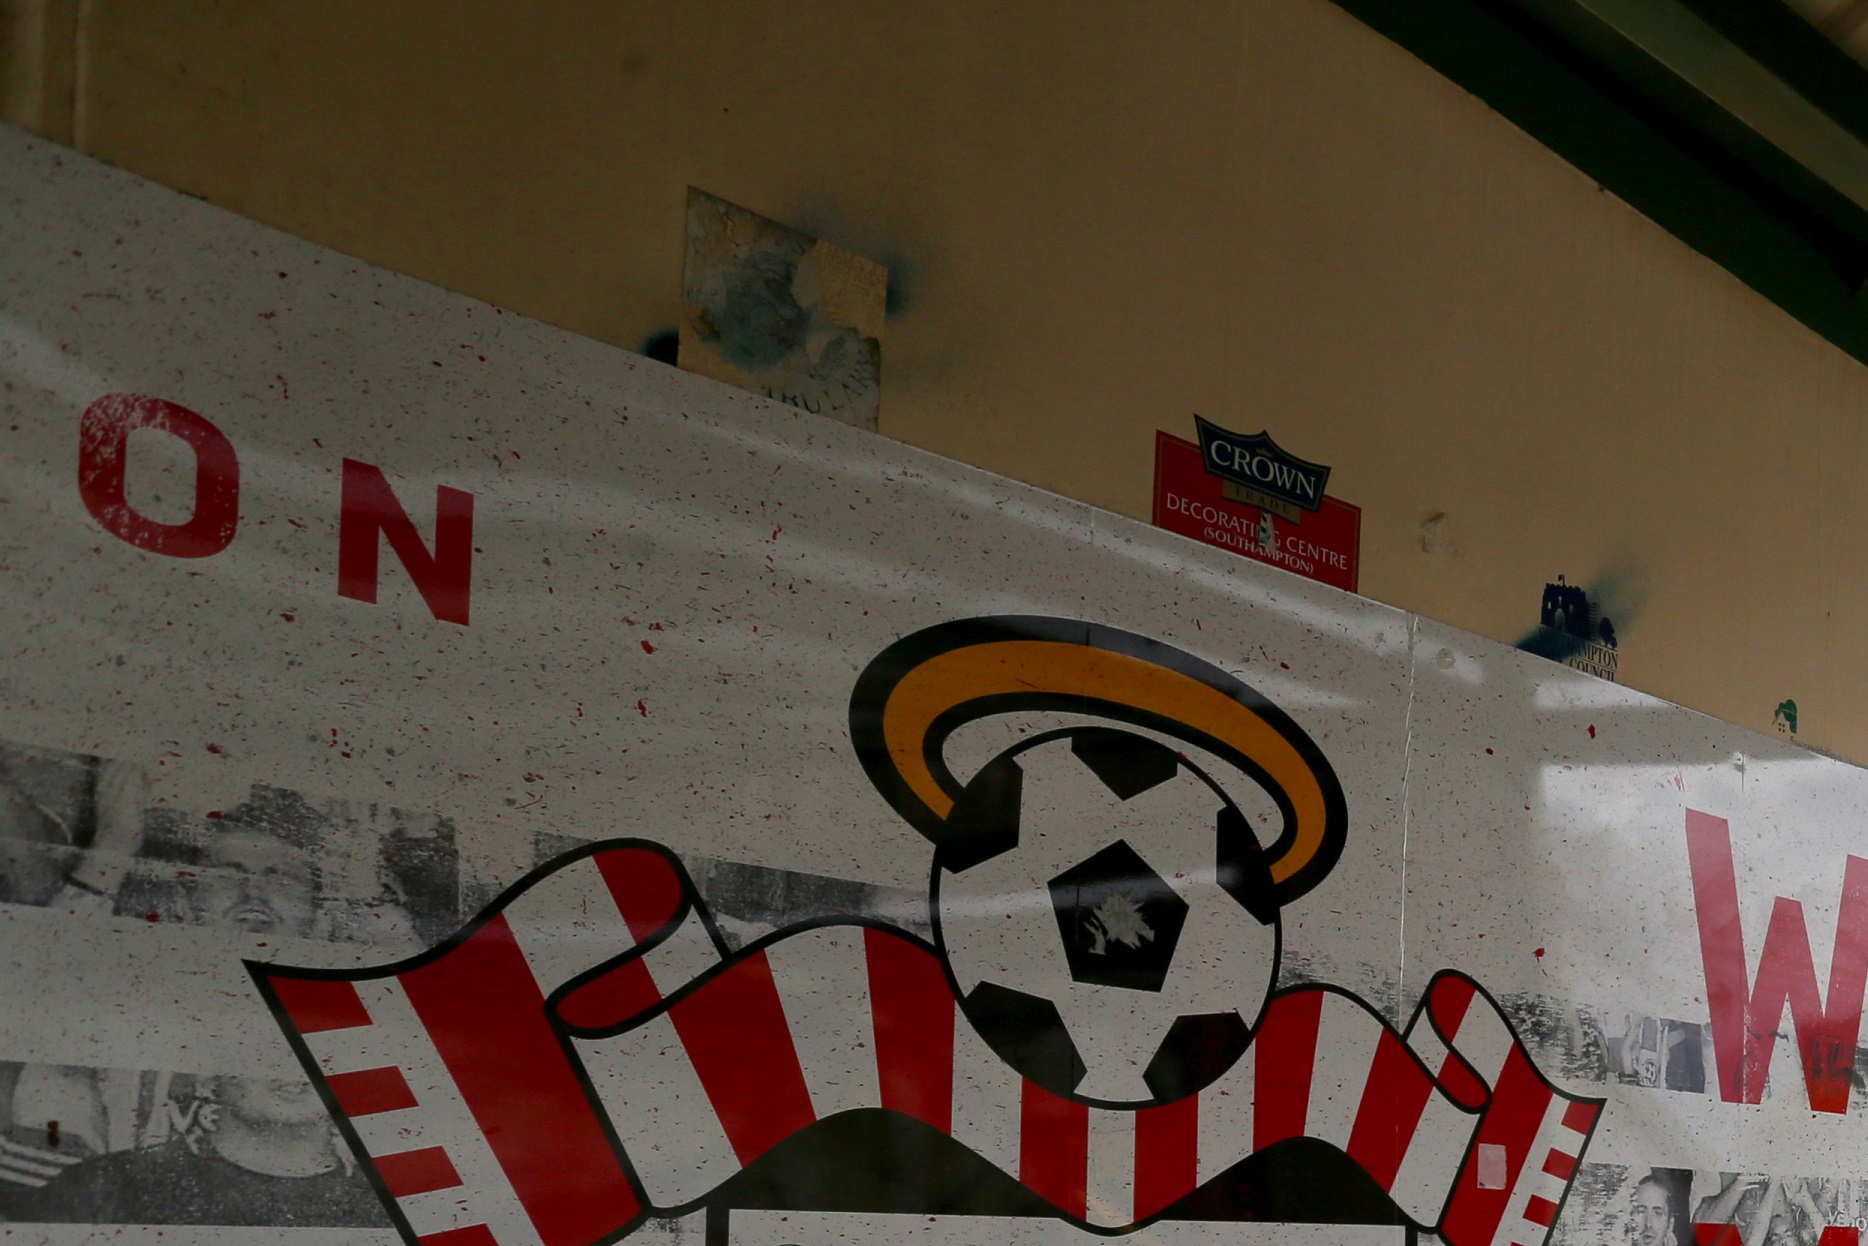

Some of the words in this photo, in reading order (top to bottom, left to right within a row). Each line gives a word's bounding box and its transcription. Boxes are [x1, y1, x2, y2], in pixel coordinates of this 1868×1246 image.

[1210, 440, 1316, 500] CROWN
[78, 395, 475, 626] ON
[1233, 484, 1291, 514] TRADE
[1286, 536, 1348, 570] CENTRE
